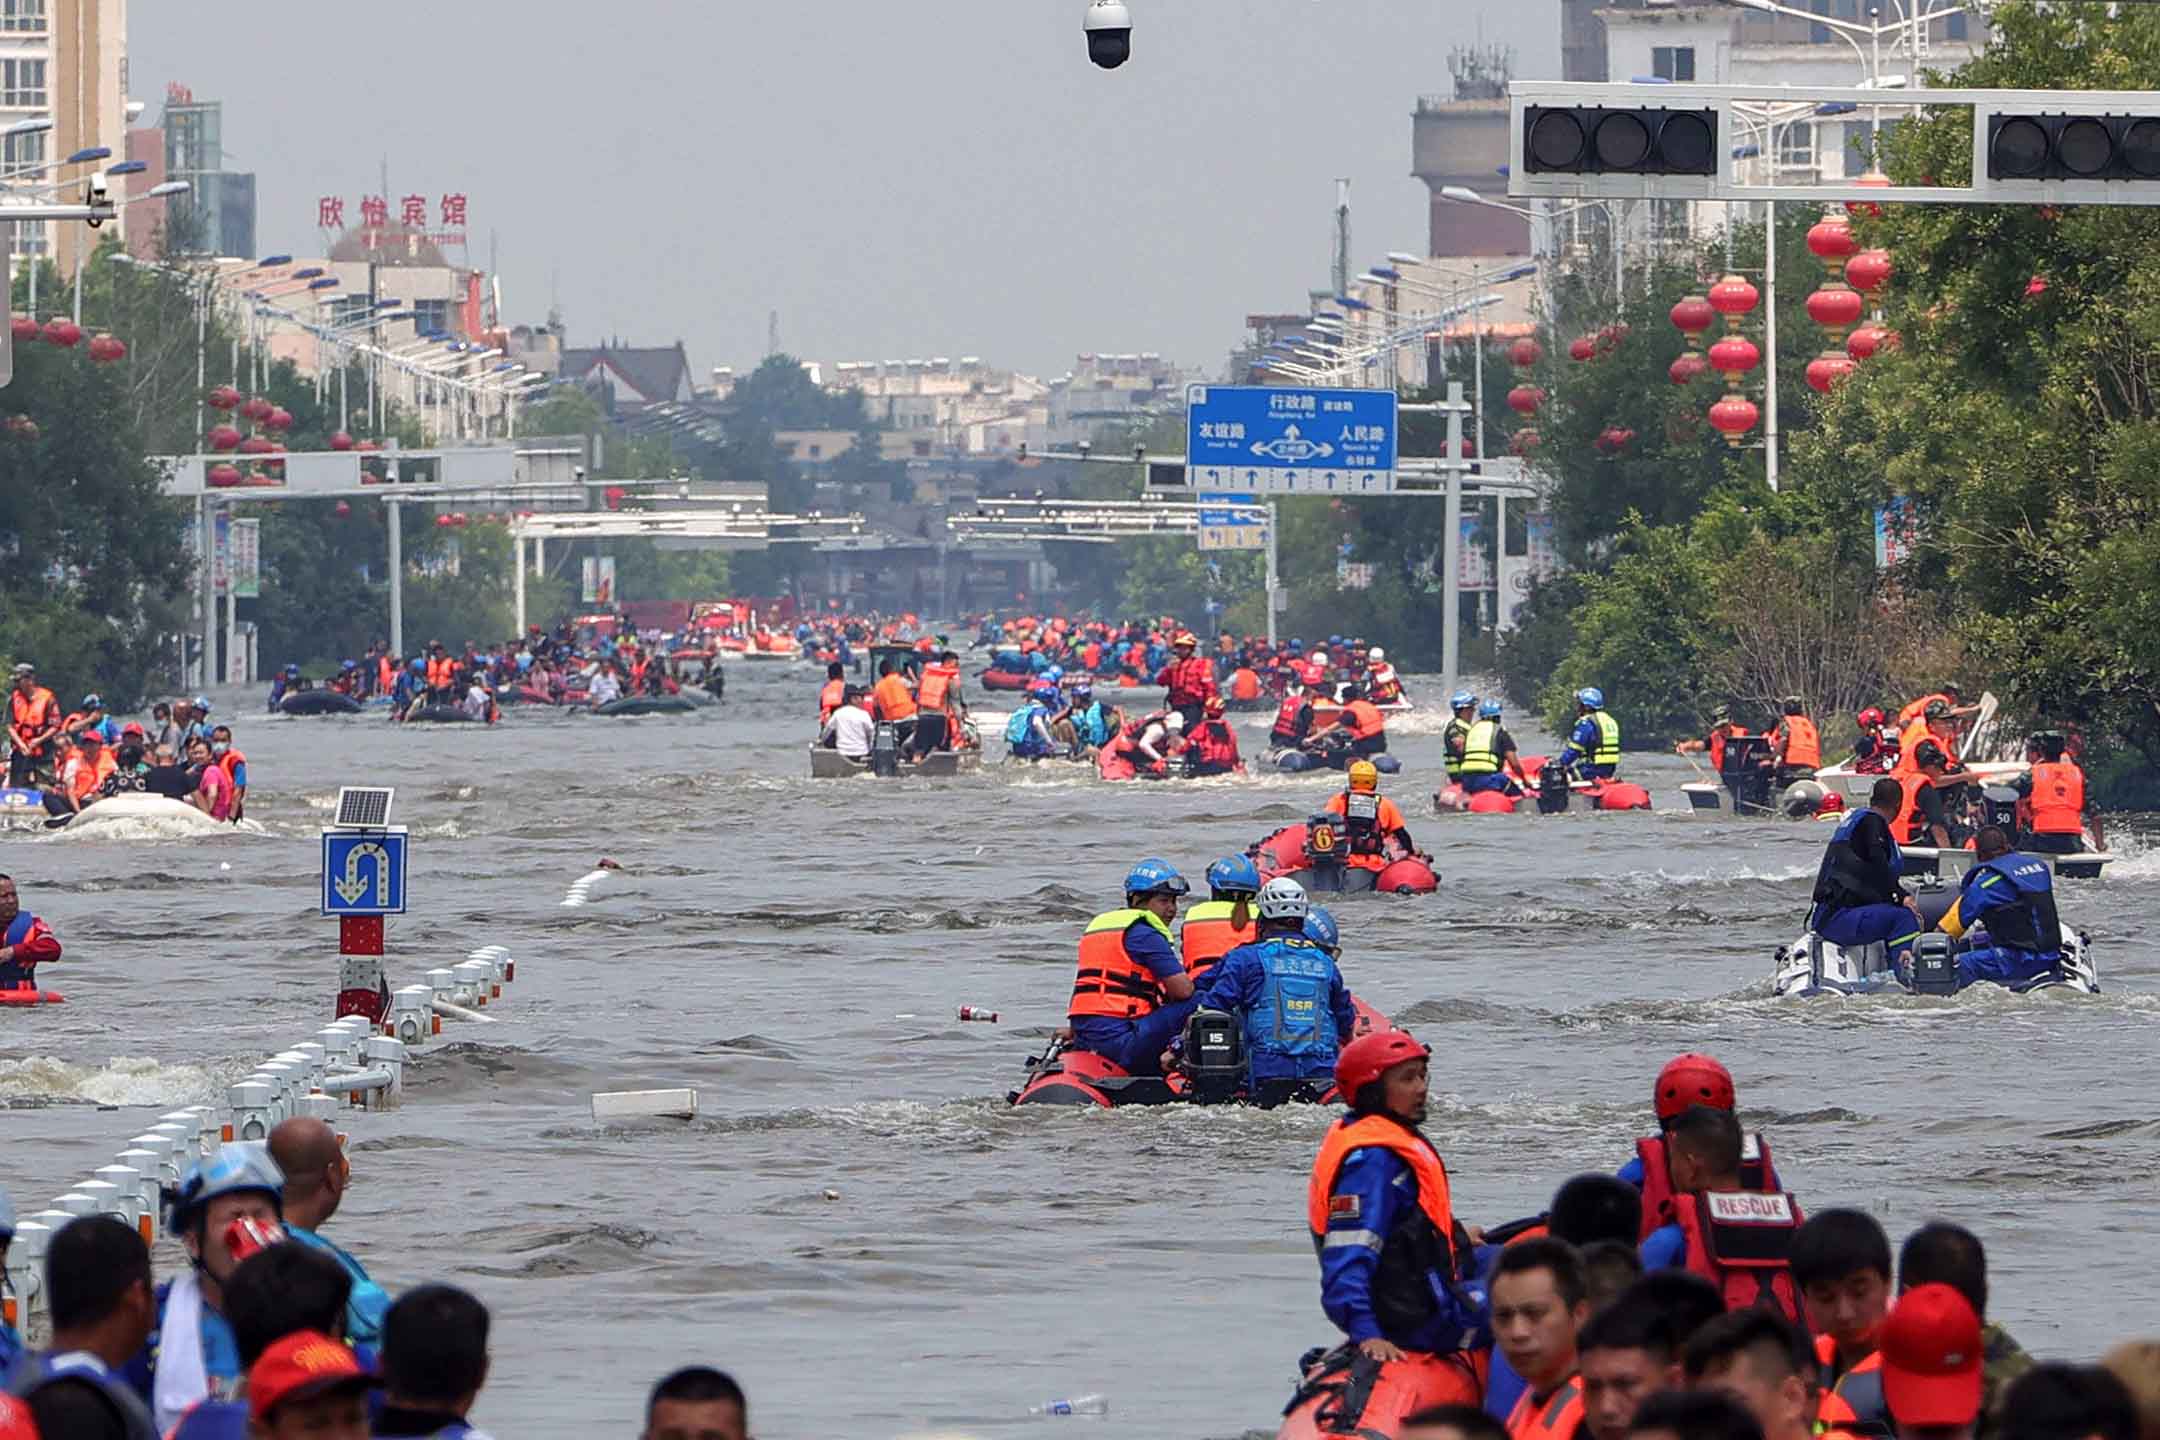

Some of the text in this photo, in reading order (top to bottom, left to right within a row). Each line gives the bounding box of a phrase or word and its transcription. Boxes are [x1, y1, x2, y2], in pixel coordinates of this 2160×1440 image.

[319, 193, 466, 229] 欣怡宾馆
[1269, 394, 1316, 410] 行政路
[1338, 425, 1385, 442] 人民路
[1996, 812, 2011, 825] 50
[1315, 828, 1332, 848] 6
[1927, 961, 1943, 969] 15
[1286, 1000, 1314, 1011] BSR
[1209, 1032, 1224, 1043] 15
[1717, 1197, 1784, 1215] RESCUE
